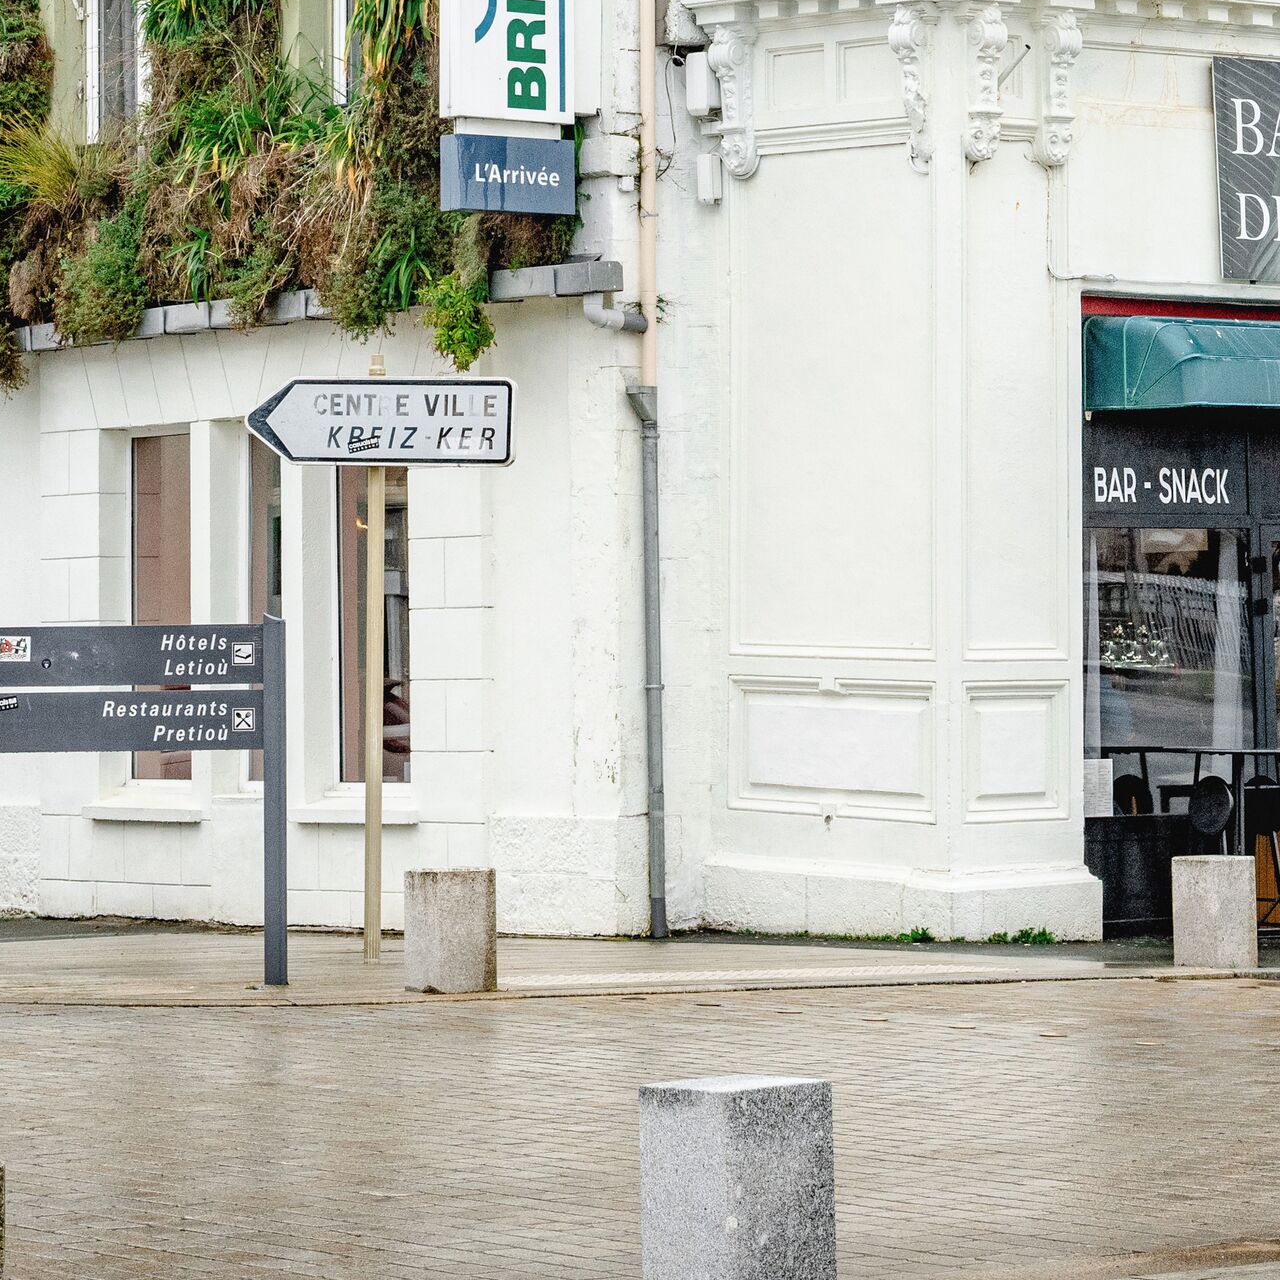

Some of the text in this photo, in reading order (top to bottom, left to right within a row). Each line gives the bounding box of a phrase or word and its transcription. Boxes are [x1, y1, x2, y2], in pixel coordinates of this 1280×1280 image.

[313, 393, 497, 417] CENTRE VILLE
[1094, 467, 1137, 503] BAR
[1158, 467, 1229, 504] SNACK
[161, 634, 227, 651] Hôtels
[164, 659, 228, 676] Letioù
[103, 701, 228, 718] Restaurants
[153, 725, 228, 742] Pretioù
